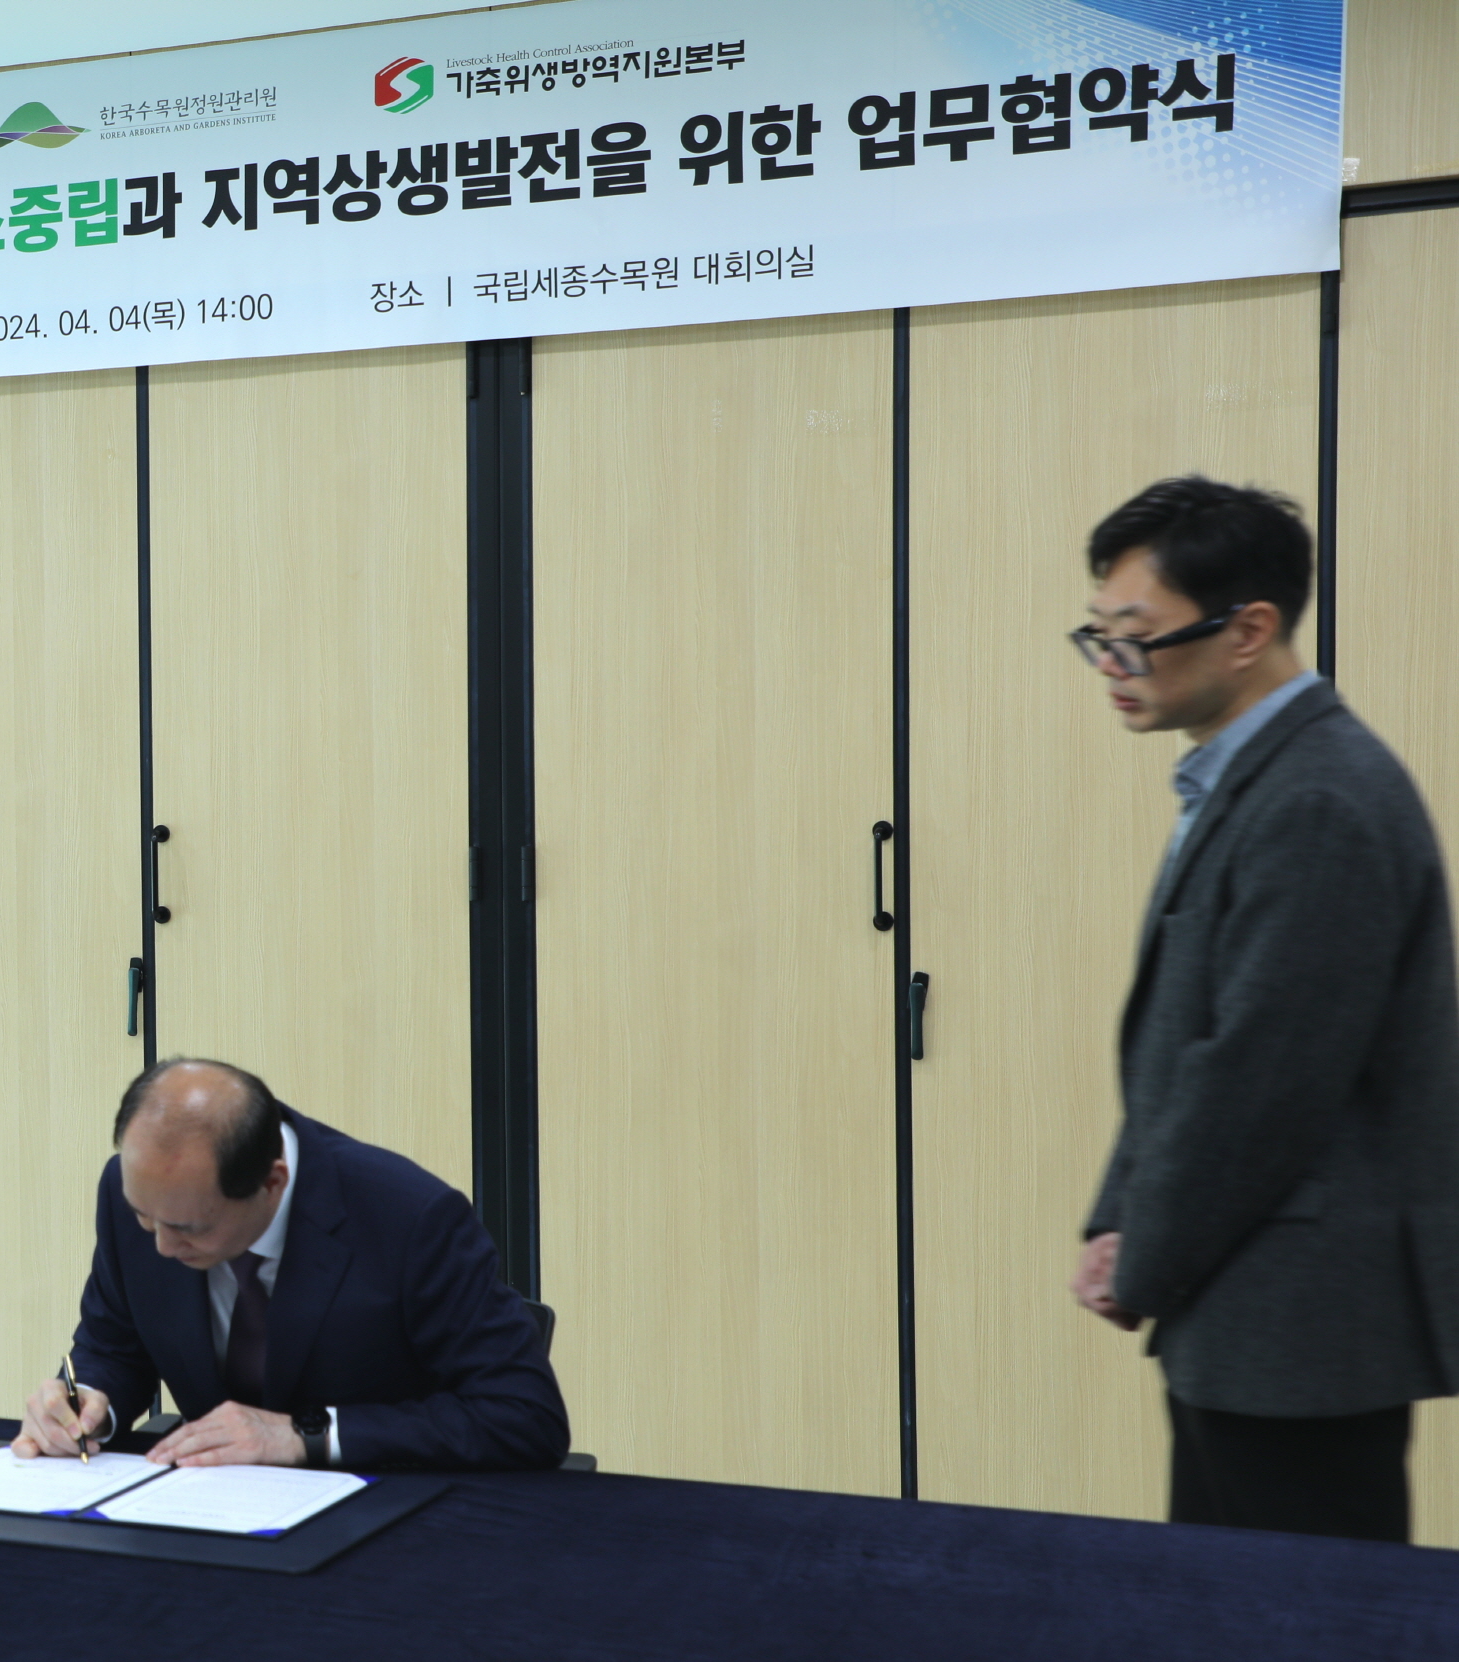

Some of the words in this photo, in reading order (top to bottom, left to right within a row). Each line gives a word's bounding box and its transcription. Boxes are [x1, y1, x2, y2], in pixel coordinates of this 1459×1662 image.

[446, 53, 493, 69] Livestock
[496, 49, 530, 63] Health
[532, 44, 572, 59] Control
[574, 39, 634, 54] Association
[446, 39, 746, 99] 가축위생방역지원본부
[99, 86, 277, 127] 한국수목원정원관리원
[100, 130, 127, 141] KOREA
[129, 125, 171, 137] ARBORETA
[173, 123, 191, 132] AND
[193, 118, 231, 130] GARDENS
[233, 113, 276, 126] INSTITUTE
[201, 121, 652, 231] 지역상생발전을
[678, 102, 822, 187] 위한
[847, 53, 1238, 171] 업무협약식
[370, 280, 425, 313] 장소
[473, 256, 679, 304] 국립세종수목원
[693, 244, 814, 285] 대회의실
[58, 309, 98, 336] 04.
[109, 298, 185, 333] 04(목)
[197, 293, 273, 324] 14:00
